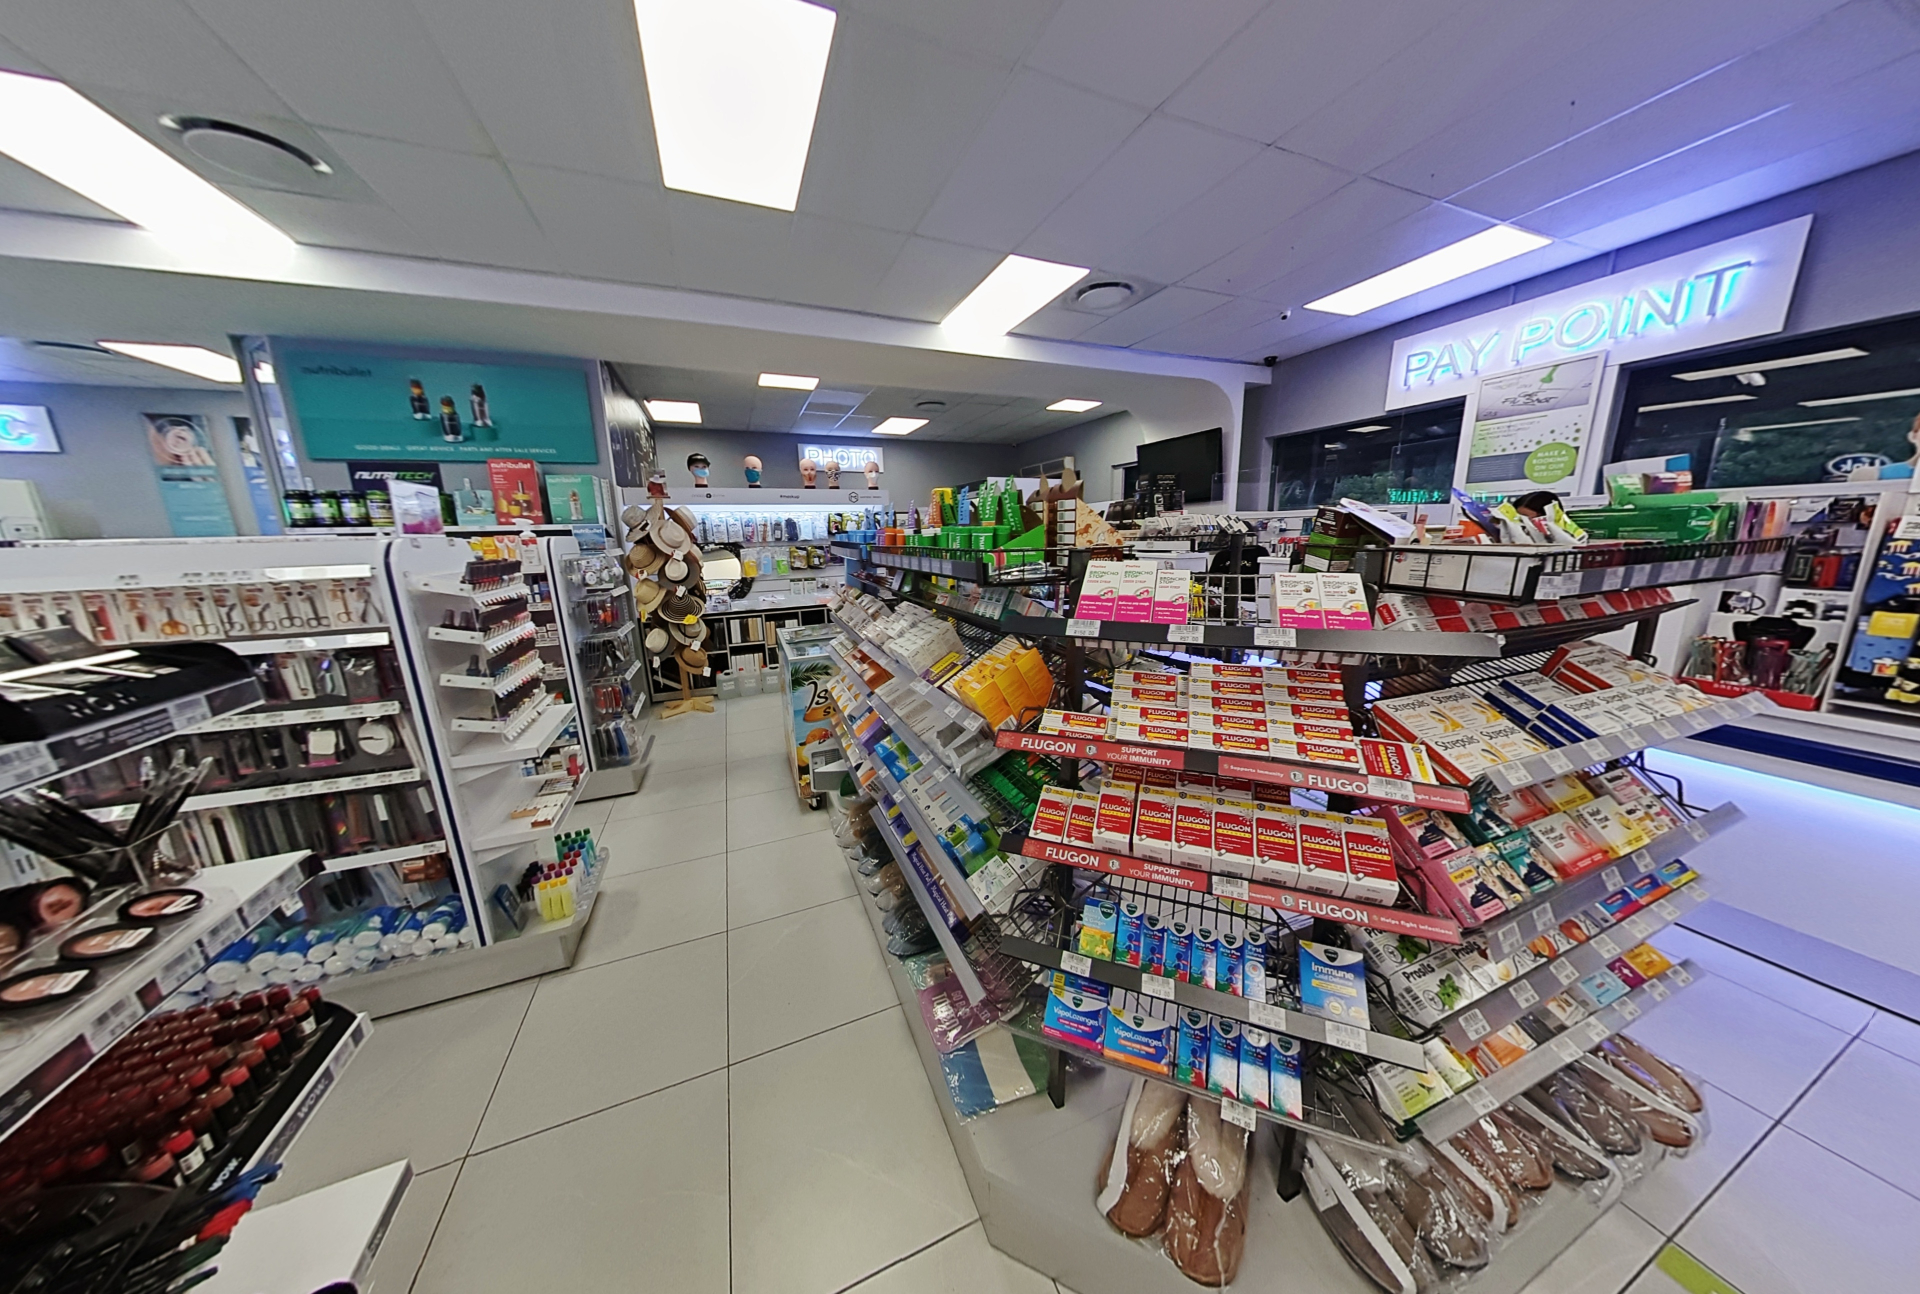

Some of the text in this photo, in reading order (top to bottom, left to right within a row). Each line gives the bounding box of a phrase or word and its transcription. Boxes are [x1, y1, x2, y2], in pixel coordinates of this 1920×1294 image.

[1403, 259, 1756, 391] PAY POINT
[805, 446, 878, 468] PHOTO
[1430, 690, 1471, 705] Strepsils
[1300, 705, 1336, 715] FLUGON
[1386, 698, 1430, 713] Strepsils
[1146, 708, 1177, 717] FLUGON
[1221, 716, 1254, 725] FLUGON
[1146, 726, 1177, 735] FLUGON
[1302, 724, 1340, 734] FLUGON
[1479, 725, 1521, 741] Strepsils
[1020, 737, 1076, 754] FLUGON
[1220, 734, 1256, 744] FLUGON
[1435, 734, 1481, 752] Strepsils
[1120, 746, 1158, 757] SUPPORT
[1305, 744, 1344, 755] FLUGON
[1106, 751, 1172, 766] YOUR IMMUNITY
[1386, 745, 1403, 776] FLUGON
[1114, 766, 1143, 776] FLUGON
[1147, 771, 1176, 781] FLUGON
[1230, 764, 1285, 778] Supports Immunity
[1308, 774, 1368, 794] FLUGO
[1256, 786, 1289, 797] FLUGON
[1039, 806, 1066, 817] FLUGON
[1100, 802, 1131, 813] FLUGON
[1140, 808, 1172, 820] FLUGON
[1177, 814, 1211, 825] FLUGON
[1216, 821, 1252, 833] FLUGON
[1258, 827, 1295, 840] FLUGON
[1301, 834, 1341, 847] FLUGON
[1348, 842, 1390, 855] FLUGON
[1045, 847, 1100, 868] FLUGON
[1143, 863, 1181, 876] SUPPORT
[1129, 868, 1195, 888] YOUR IMMUNITY
[1298, 899, 1370, 924] FLUGON
[1380, 916, 1400, 925] Helps
[1418, 923, 1454, 936] infections
[1247, 944, 1262, 954] First
[1451, 940, 1481, 959] Prosils
[1311, 961, 1355, 980] Immune
[1401, 962, 1436, 984] Prosils
[1053, 1005, 1099, 1027] VapoLozenges
[1113, 1026, 1163, 1048] VapoLozenges
[1226, 1039, 1237, 1048] Plus
[1256, 1048, 1268, 1057] Plus
[1287, 1057, 1298, 1065] Plus
